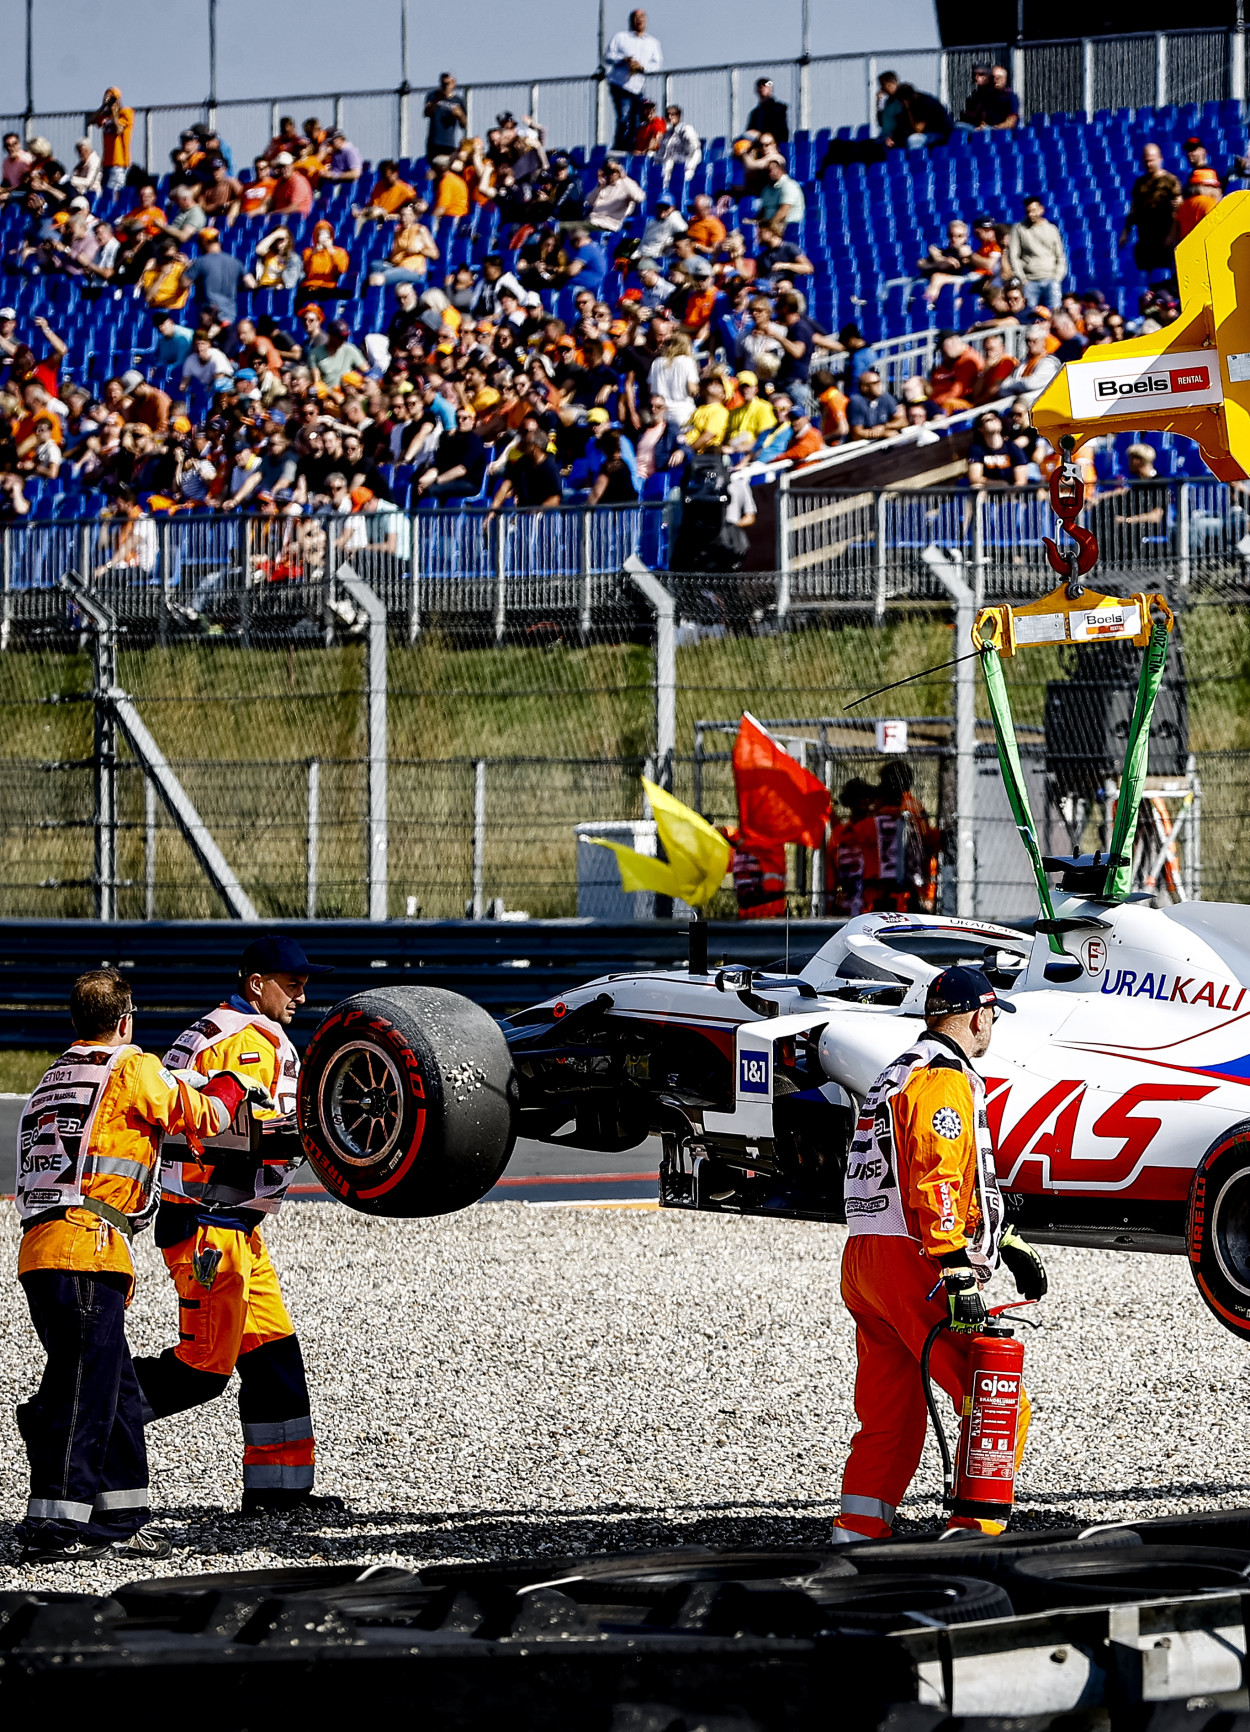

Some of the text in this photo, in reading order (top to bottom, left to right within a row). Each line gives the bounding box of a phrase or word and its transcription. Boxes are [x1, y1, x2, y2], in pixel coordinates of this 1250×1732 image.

[1098, 375, 1203, 397] Boels RENTAL
[1087, 614, 1122, 624] Boels
[1149, 649, 1165, 674] WLL
[884, 725, 897, 746] F
[1101, 969, 1247, 1011] URALKALI
[344, 1010, 425, 1099] P ZERO
[742, 1059, 766, 1084] 1&1
[304, 1134, 350, 1197] PIRELLI
[939, 1181, 953, 1217] TOTAL
[1190, 1175, 1206, 1263] PIRELLI
[981, 1375, 1017, 1397] ajax
